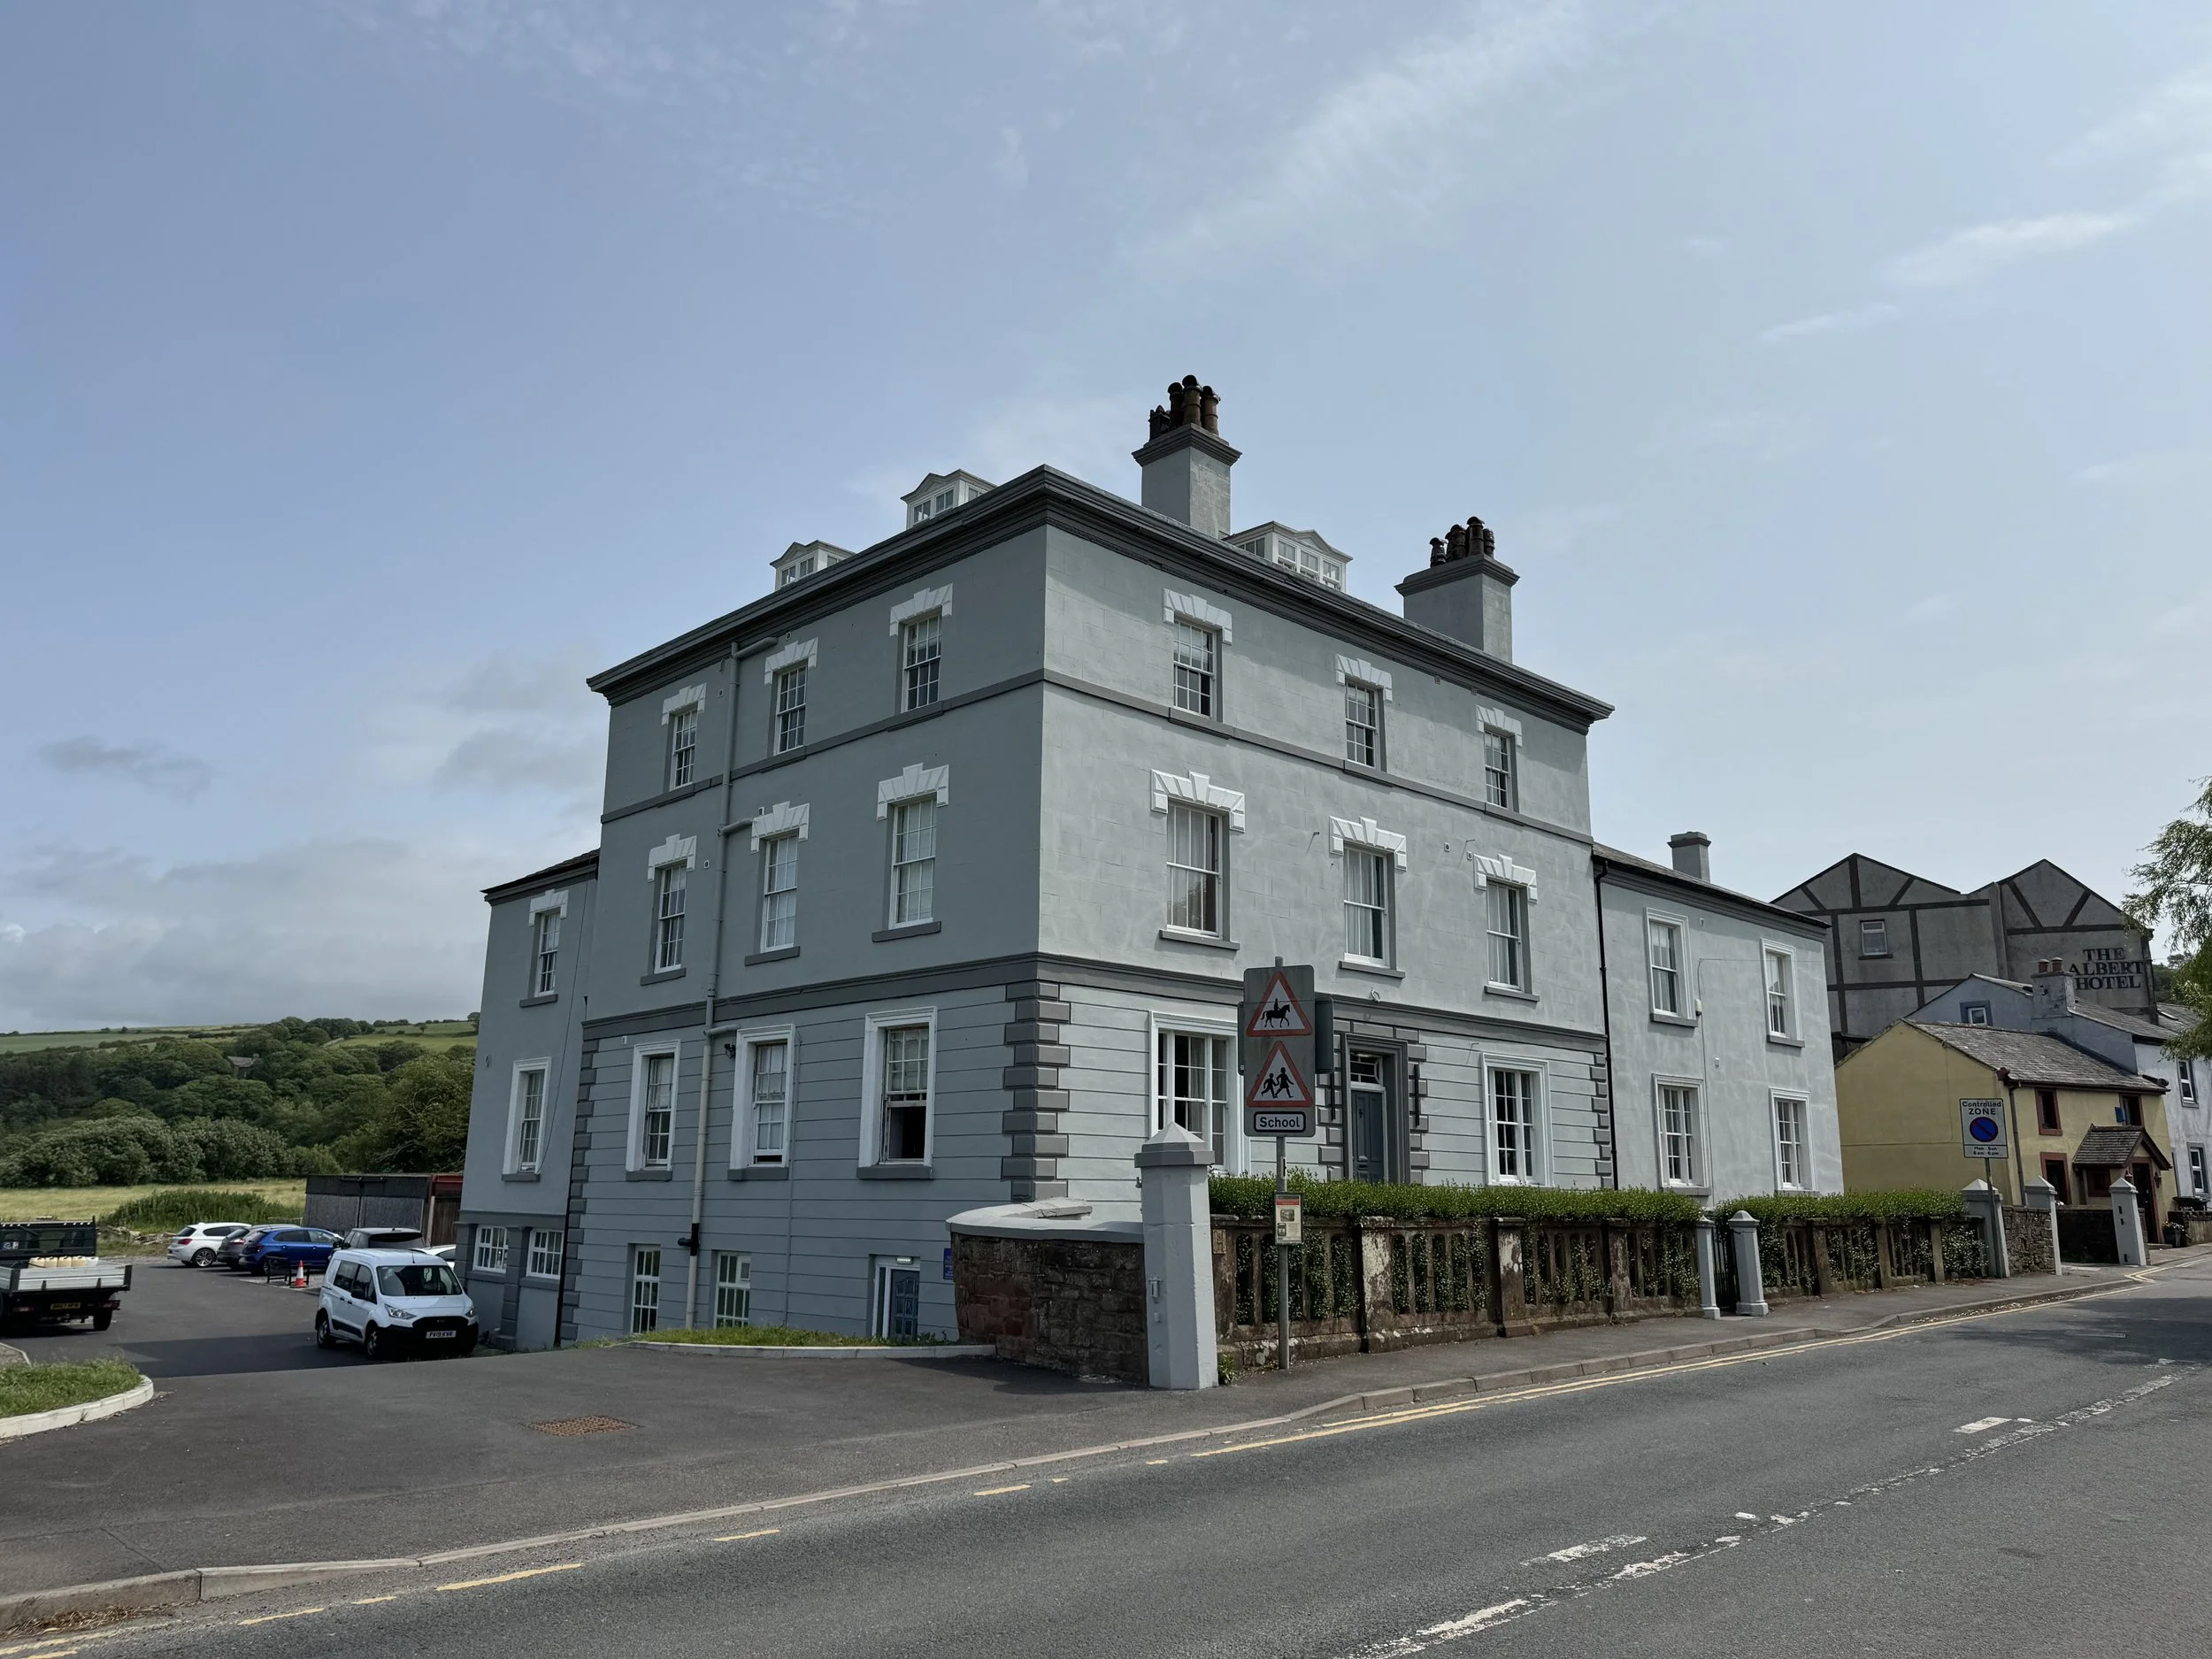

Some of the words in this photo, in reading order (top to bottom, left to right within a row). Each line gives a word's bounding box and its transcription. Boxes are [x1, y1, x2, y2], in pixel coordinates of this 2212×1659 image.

[2083, 948, 2125, 961] THE
[2070, 962, 2144, 975] ALBERT
[2074, 976, 2141, 990] HOTEL
[1259, 1117, 1300, 1127] School
